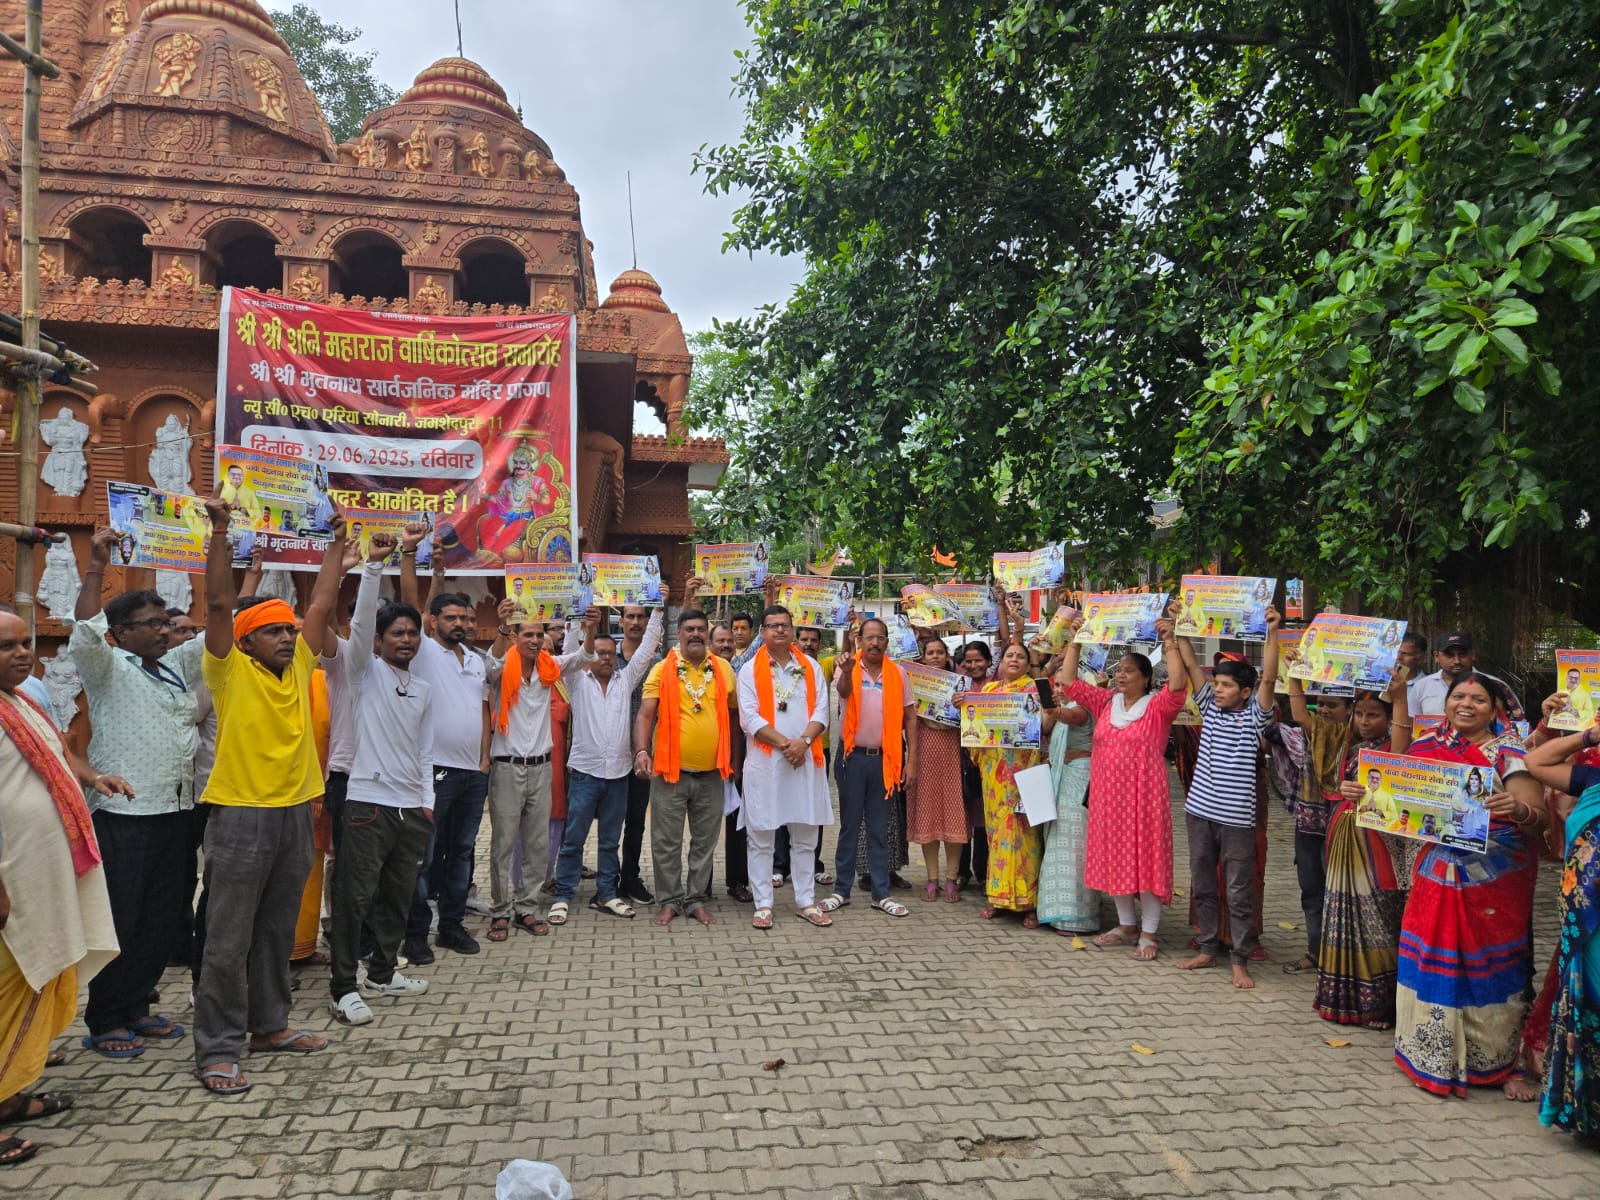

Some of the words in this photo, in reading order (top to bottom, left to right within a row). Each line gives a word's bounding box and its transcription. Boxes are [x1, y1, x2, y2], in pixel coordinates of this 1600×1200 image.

[236, 311, 256, 346] श्री
[261, 316, 282, 350] श्री
[287, 320, 321, 356] शनि
[323, 332, 394, 362] महाराज
[398, 330, 498, 367] वार्षिकोत्सव
[502, 333, 562, 368] समारोह
[249, 360, 270, 382] श्री
[273, 363, 295, 386] श्री
[300, 370, 362, 397] भुतनाथ
[365, 374, 456, 400] सार्वजनिक
[460, 378, 502, 400] मंदिर
[506, 377, 551, 400] प्रांगण
[243, 399, 262, 419] न्यू
[322, 405, 359, 425] एरिया
[363, 409, 411, 429] सोनारी,
[251, 434, 304, 456] दिनांक
[420, 448, 475, 469] रविवार
[366, 487, 439, 512] आमंत्रित
[443, 489, 457, 514] है
[255, 534, 269, 548] श्री
[270, 536, 309, 552] भूतनाथ
